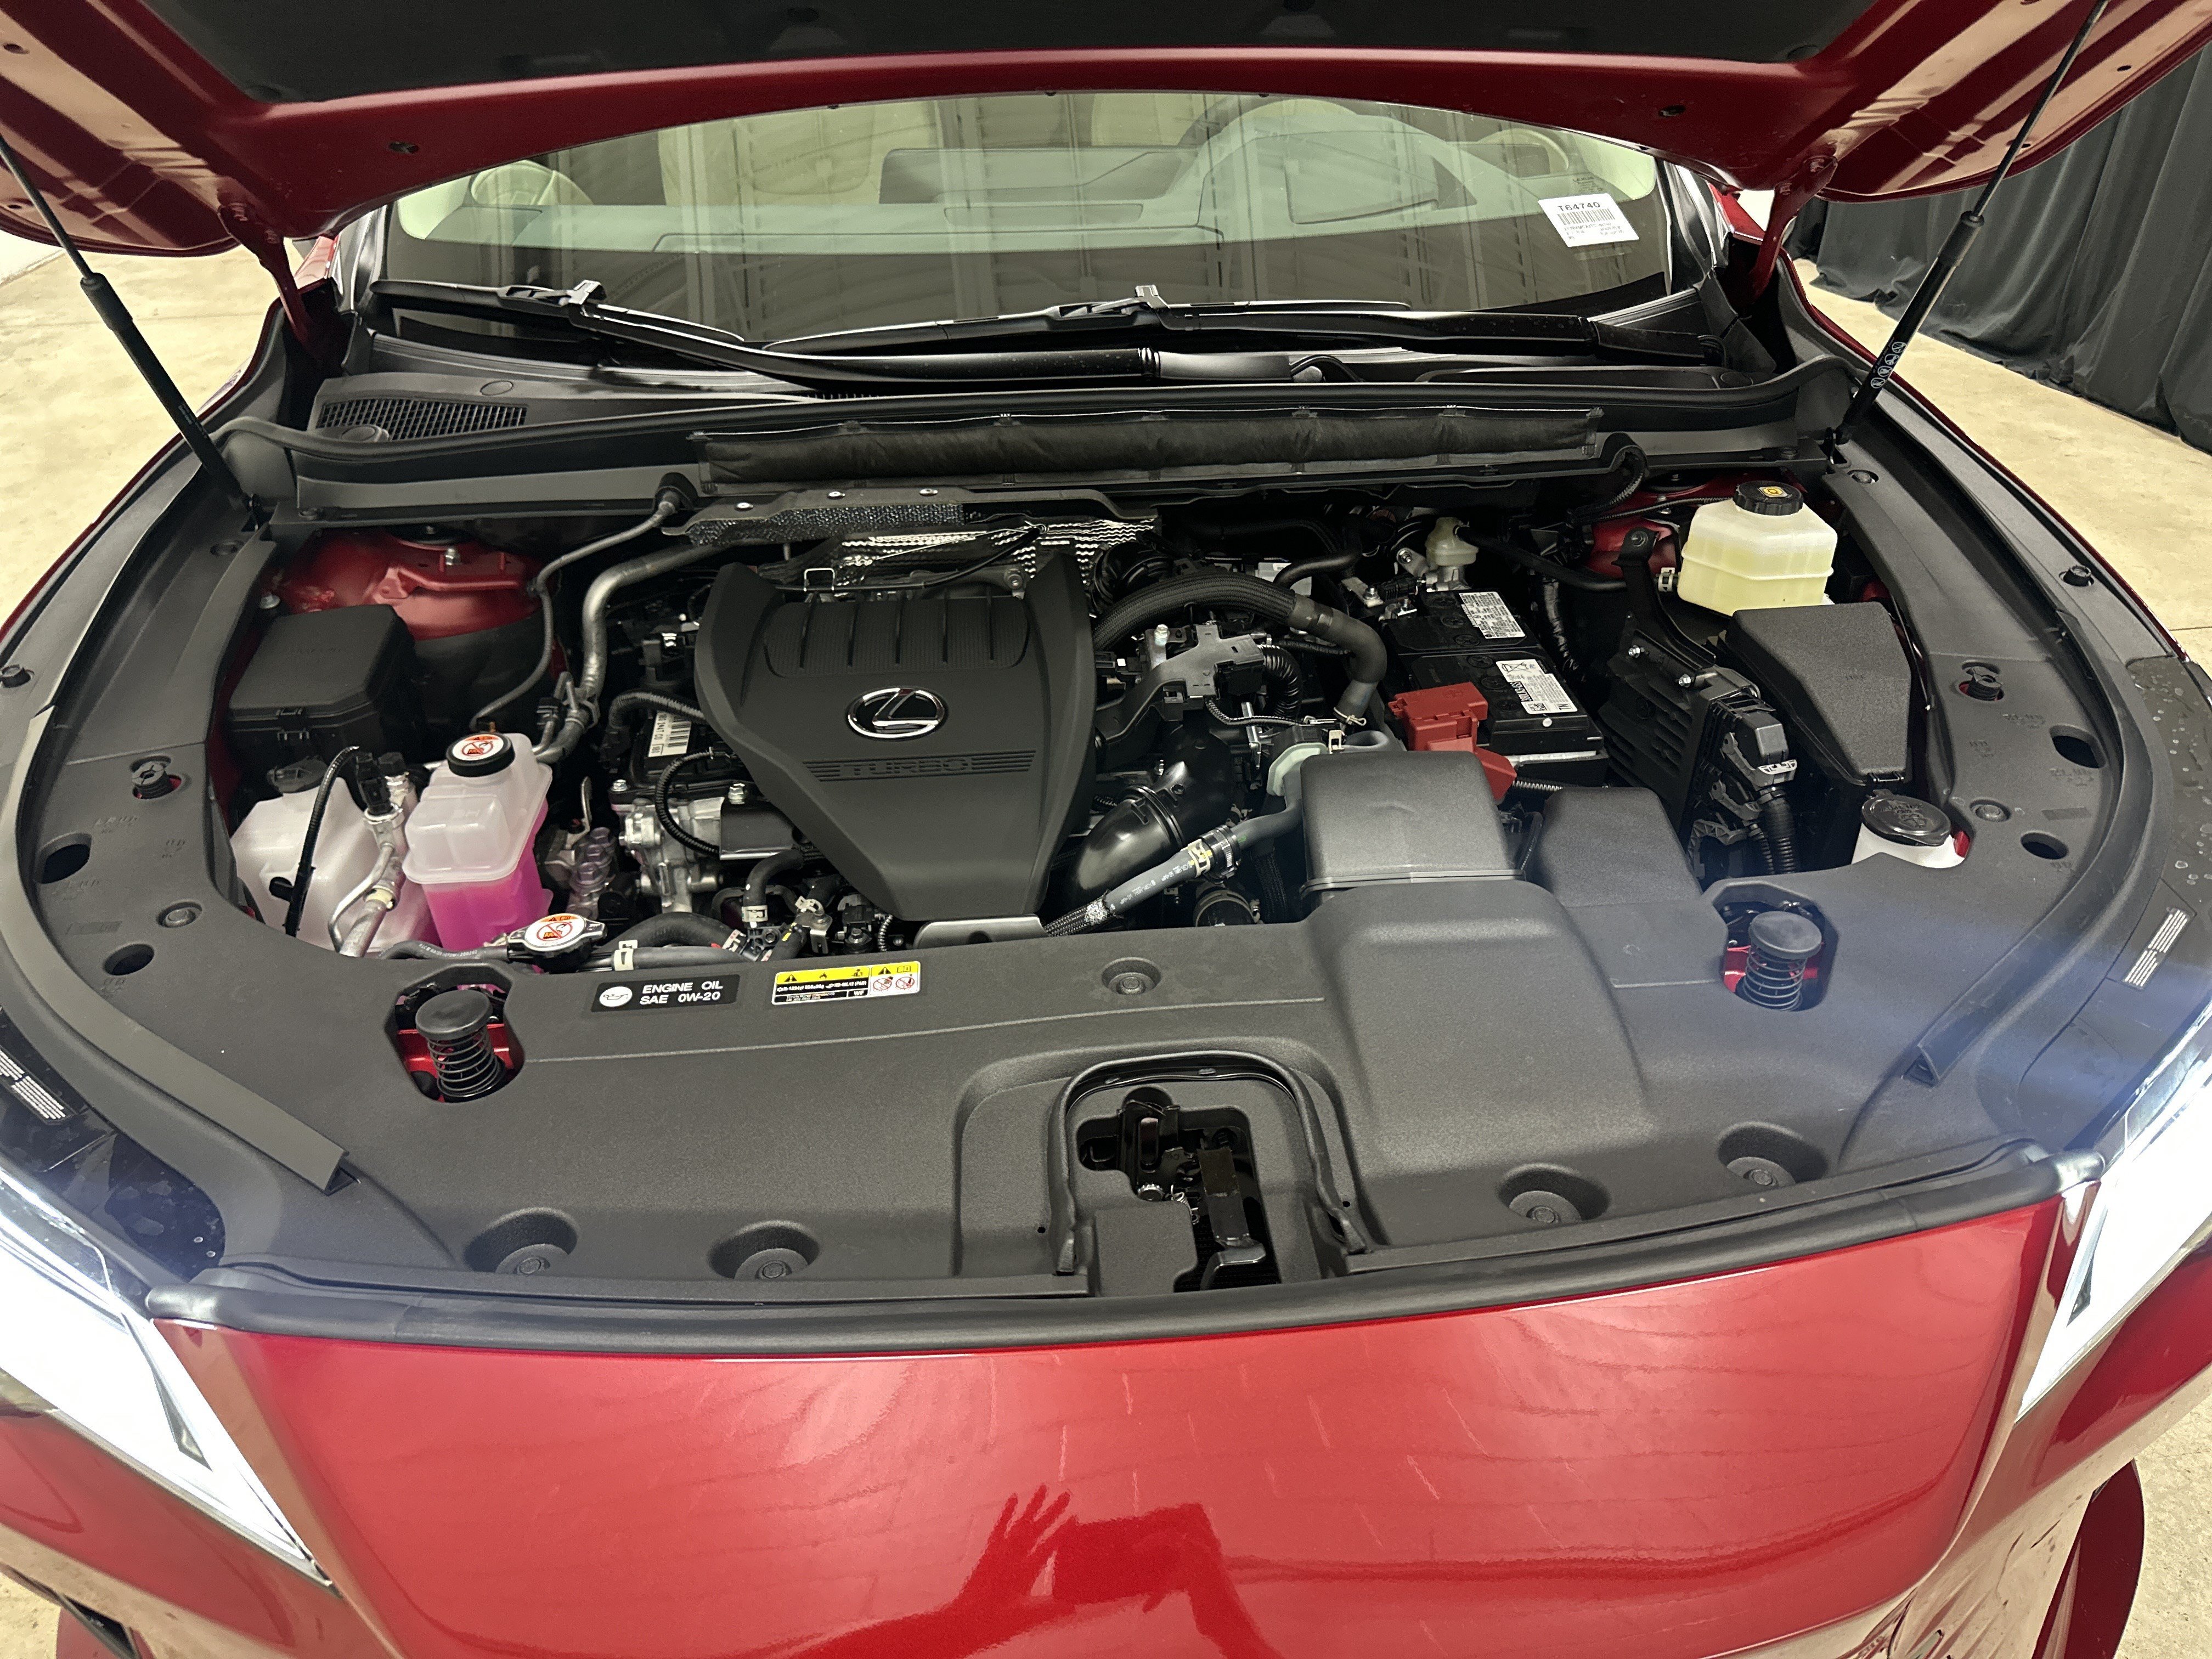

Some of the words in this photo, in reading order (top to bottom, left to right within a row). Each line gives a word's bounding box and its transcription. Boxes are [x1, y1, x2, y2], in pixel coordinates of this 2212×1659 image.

[1558, 202, 1601, 212] T64740
[844, 758, 968, 775] TURBO
[642, 982, 693, 994] ENGINE
[701, 980, 723, 990] OIL
[640, 994, 669, 1005] SAE
[678, 991, 720, 1003] 0W-20
